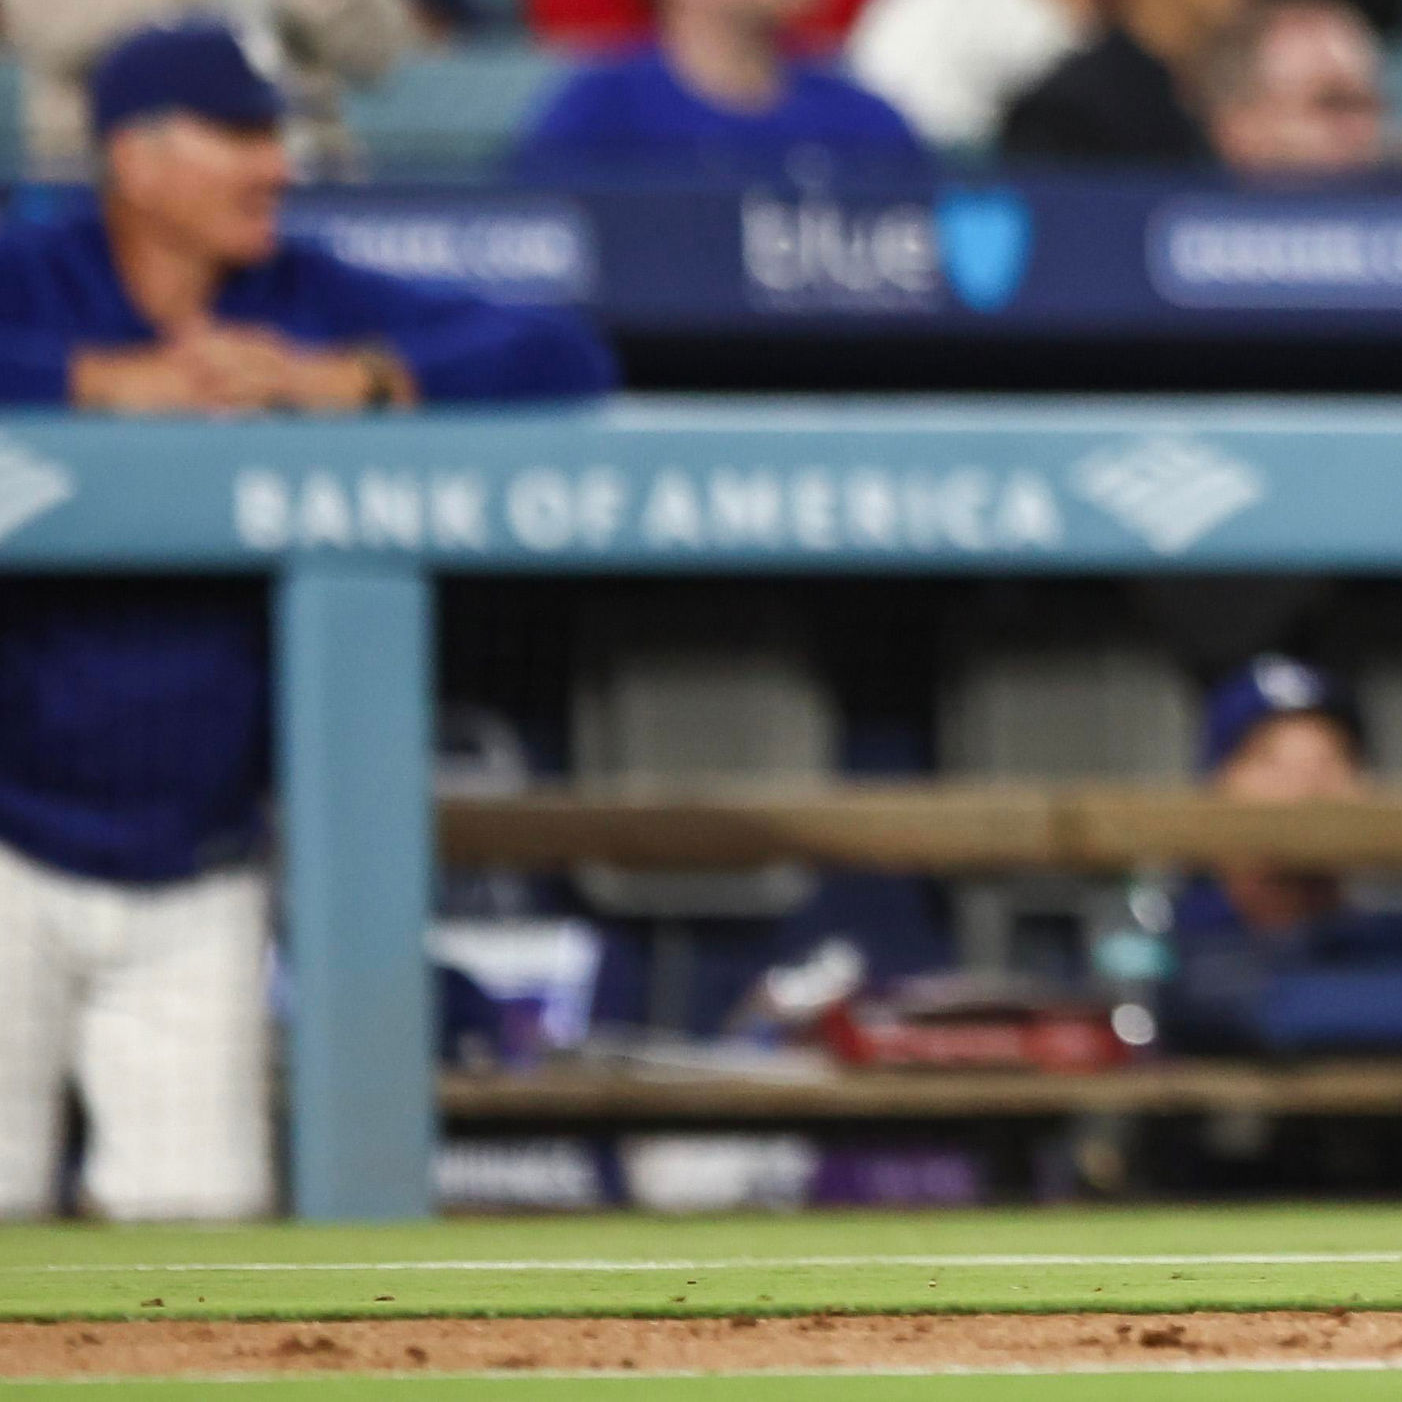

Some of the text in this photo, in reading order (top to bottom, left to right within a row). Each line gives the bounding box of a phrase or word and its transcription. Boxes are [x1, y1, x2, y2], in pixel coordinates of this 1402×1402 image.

[742, 196, 938, 290] blue
[234, 467, 1064, 551] BANK OF AMERICA
